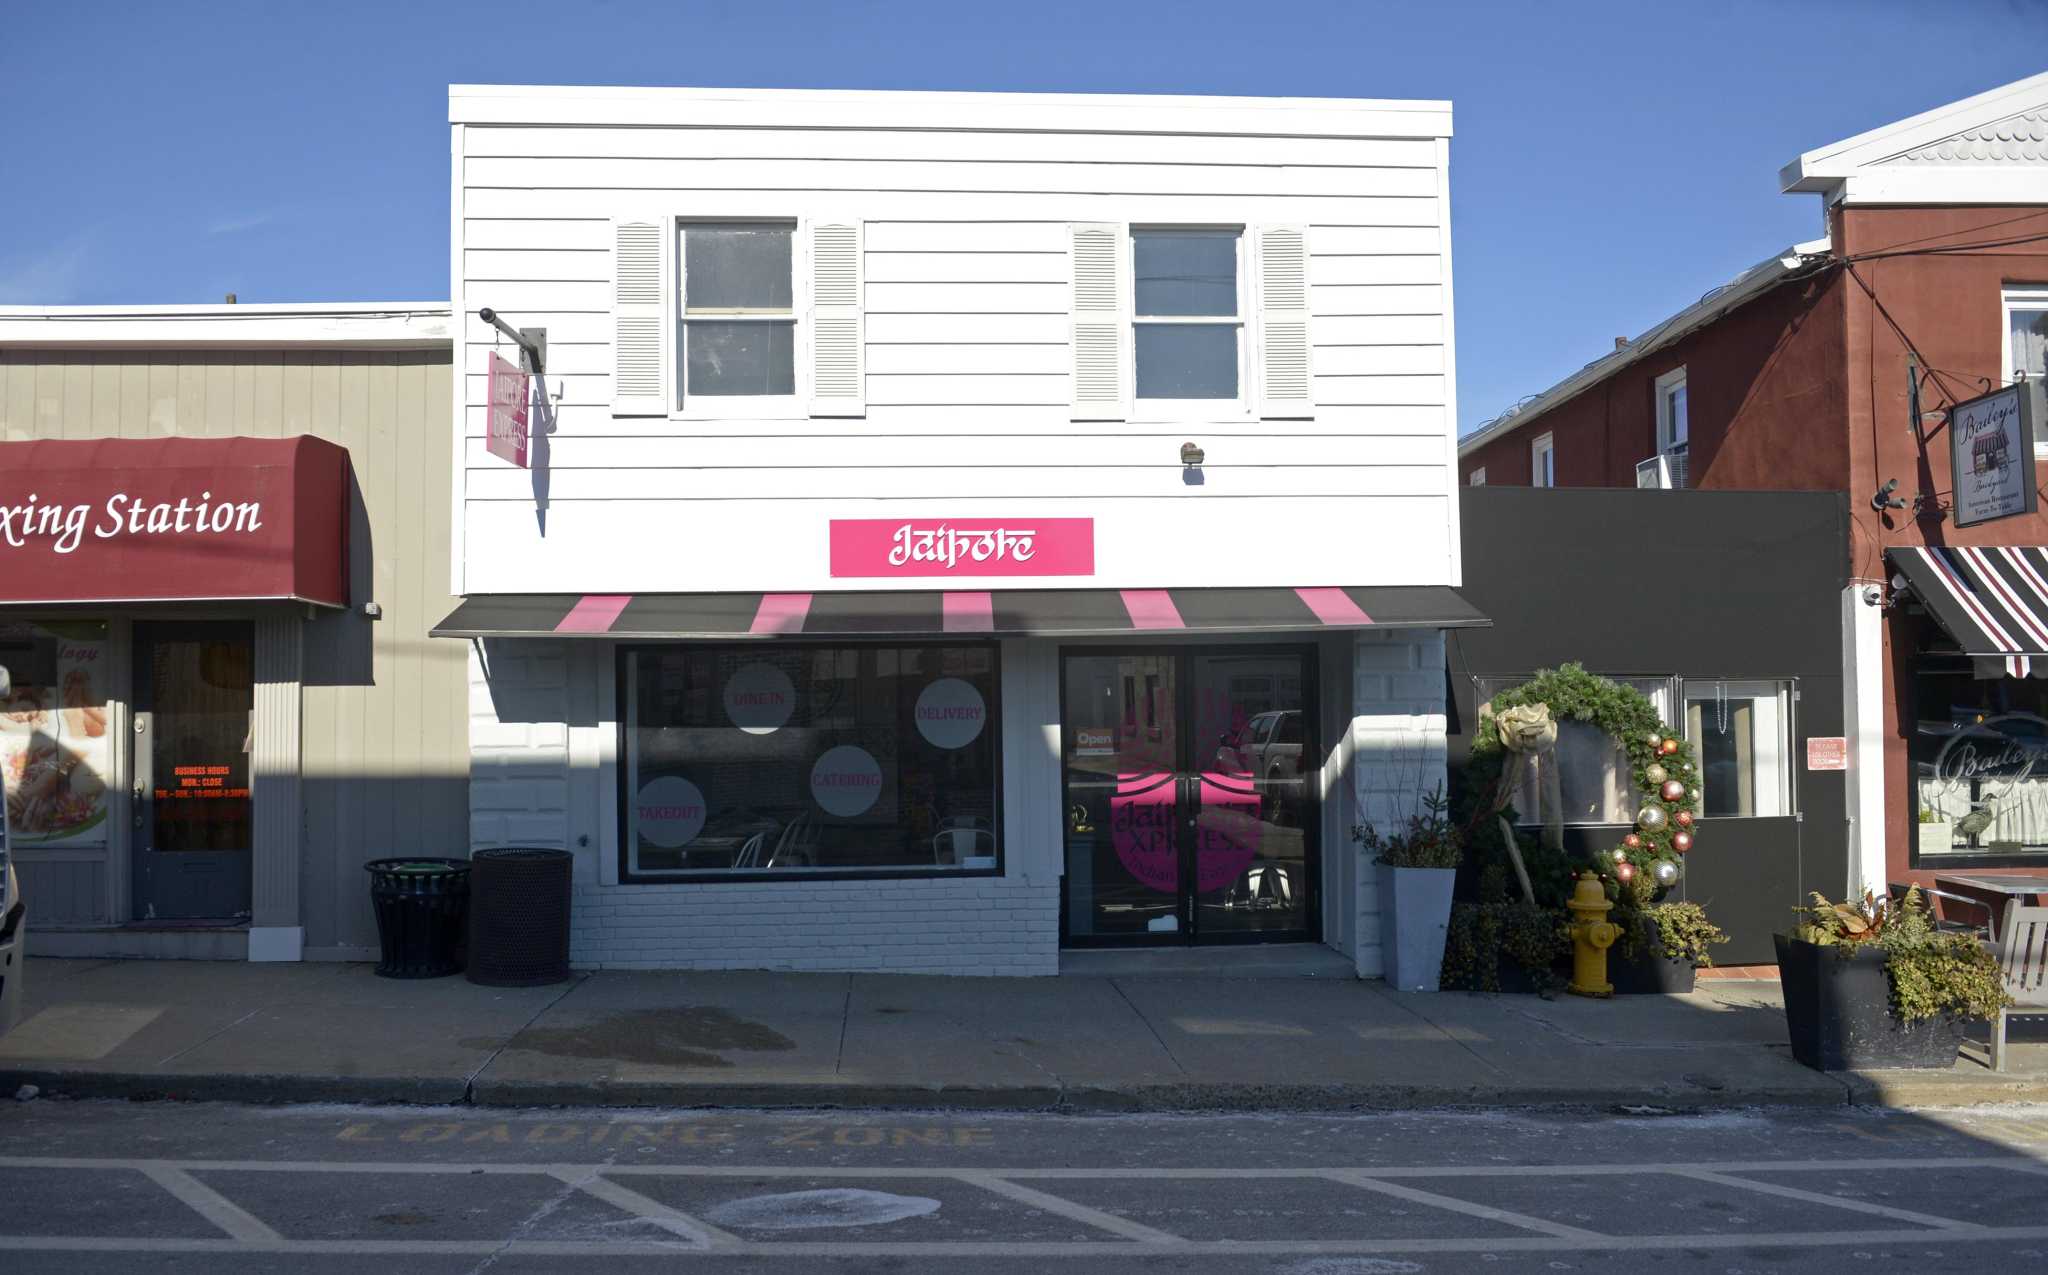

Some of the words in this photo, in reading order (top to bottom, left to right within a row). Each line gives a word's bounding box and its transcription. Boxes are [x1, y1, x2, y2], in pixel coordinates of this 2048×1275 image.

[1960, 397, 2019, 446] Bailey's
[95, 491, 263, 537] Station
[917, 706, 983, 721] DELIVERY
[1077, 732, 1112, 746] Open
[175, 766, 206, 775] BUSINESS
[207, 766, 230, 775] HOURS
[812, 774, 880, 788] CATERING
[335, 1120, 733, 1146] LOADING
[770, 1126, 994, 1146] ZONE
